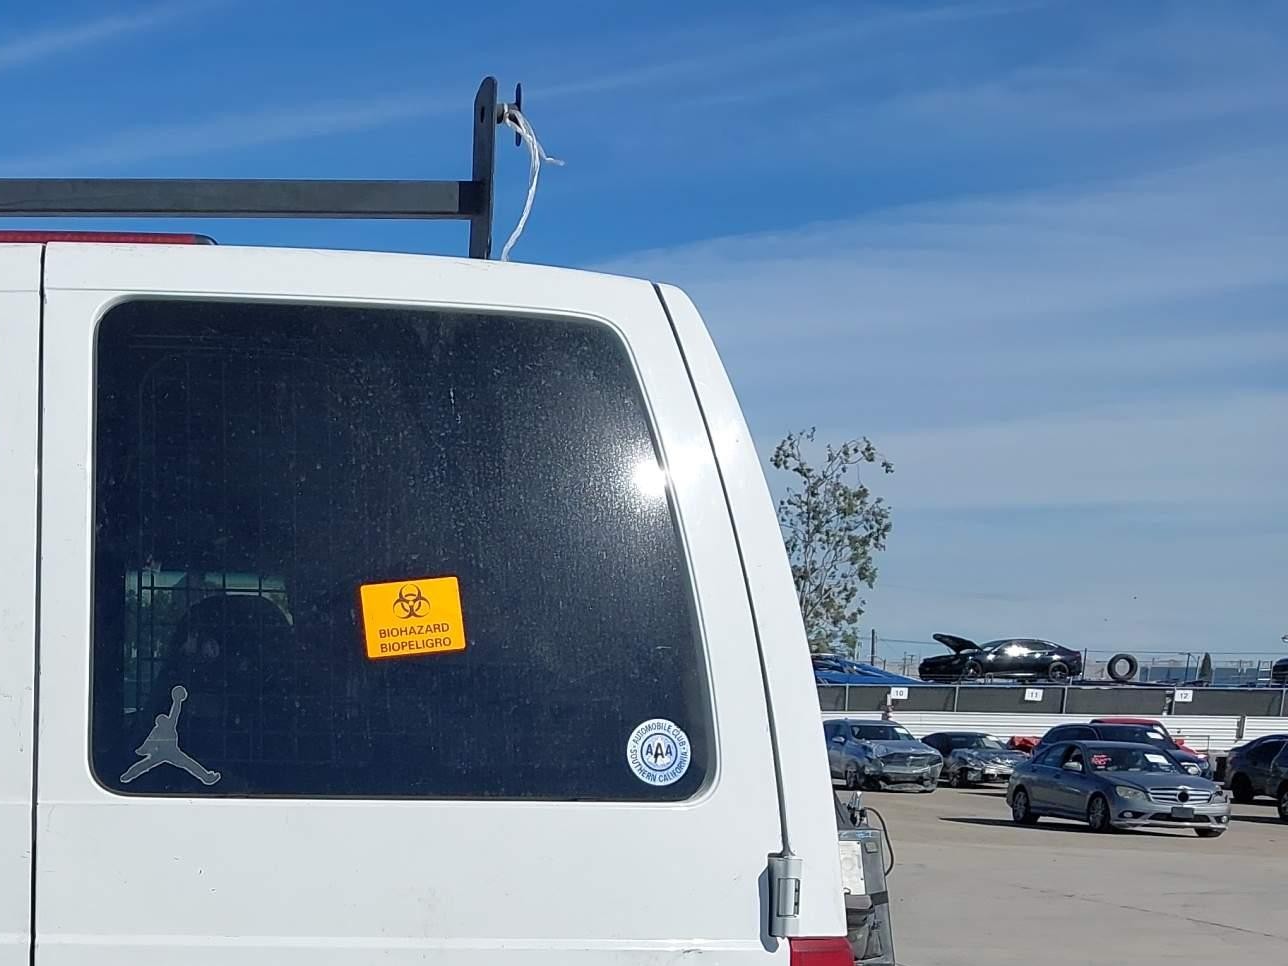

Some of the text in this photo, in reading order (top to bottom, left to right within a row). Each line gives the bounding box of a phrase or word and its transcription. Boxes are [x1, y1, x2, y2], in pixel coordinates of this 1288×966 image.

[378, 622, 450, 639] BIOHAZARD
[380, 636, 452, 653] BIOPELIGRO
[632, 721, 687, 748] AUTOMOBILE CLUB
[645, 742, 673, 764] AAA
[629, 748, 689, 783] SOUTHERN CALIFORNIA
